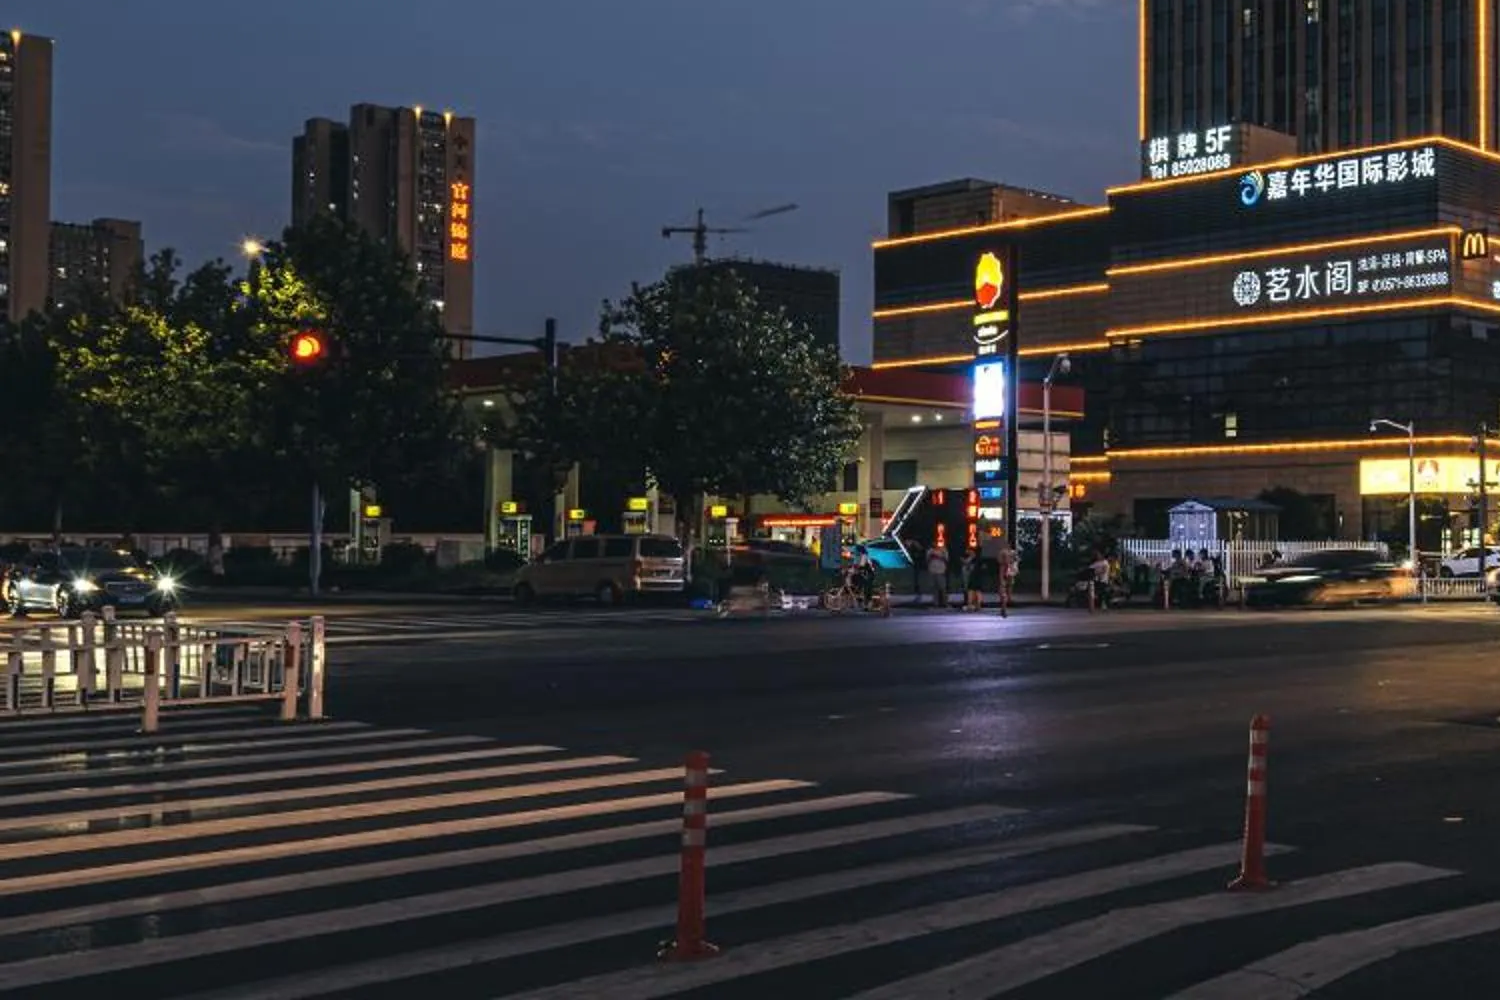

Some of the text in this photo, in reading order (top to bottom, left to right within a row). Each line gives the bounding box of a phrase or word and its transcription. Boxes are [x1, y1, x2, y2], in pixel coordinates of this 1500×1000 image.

[1205, 125, 1232, 153] 5F
[1149, 163, 1167, 180] Tel
[1267, 147, 1435, 200] 嘉年华国际影城
[1463, 232, 1486, 257] M
[1265, 260, 1352, 302] 茗水阁
